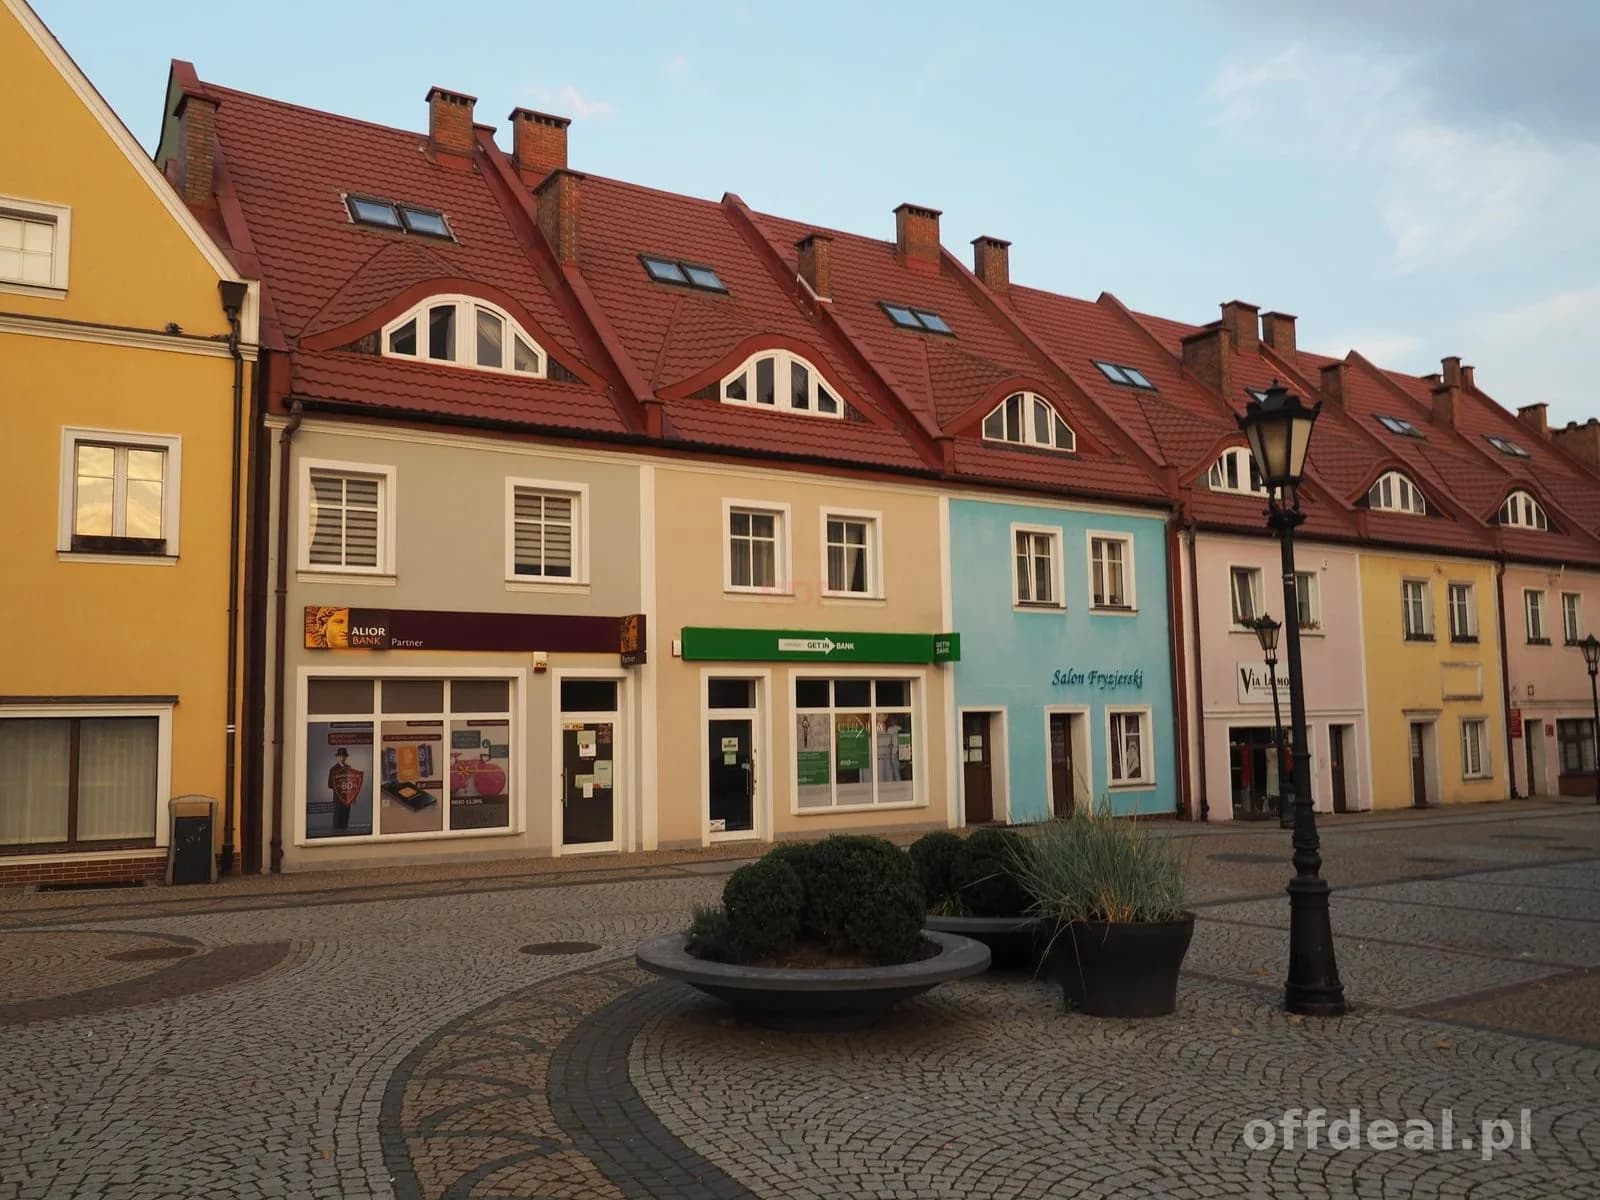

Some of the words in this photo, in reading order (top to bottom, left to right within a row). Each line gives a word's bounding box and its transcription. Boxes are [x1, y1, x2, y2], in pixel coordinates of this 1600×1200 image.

[352, 627, 386, 636] ALIOR
[352, 637, 381, 645] BANK
[391, 638, 424, 647] Partner
[836, 642, 855, 650] BANK
[1052, 667, 1084, 686] Salon
[1088, 668, 1144, 690] Fryzjerski
